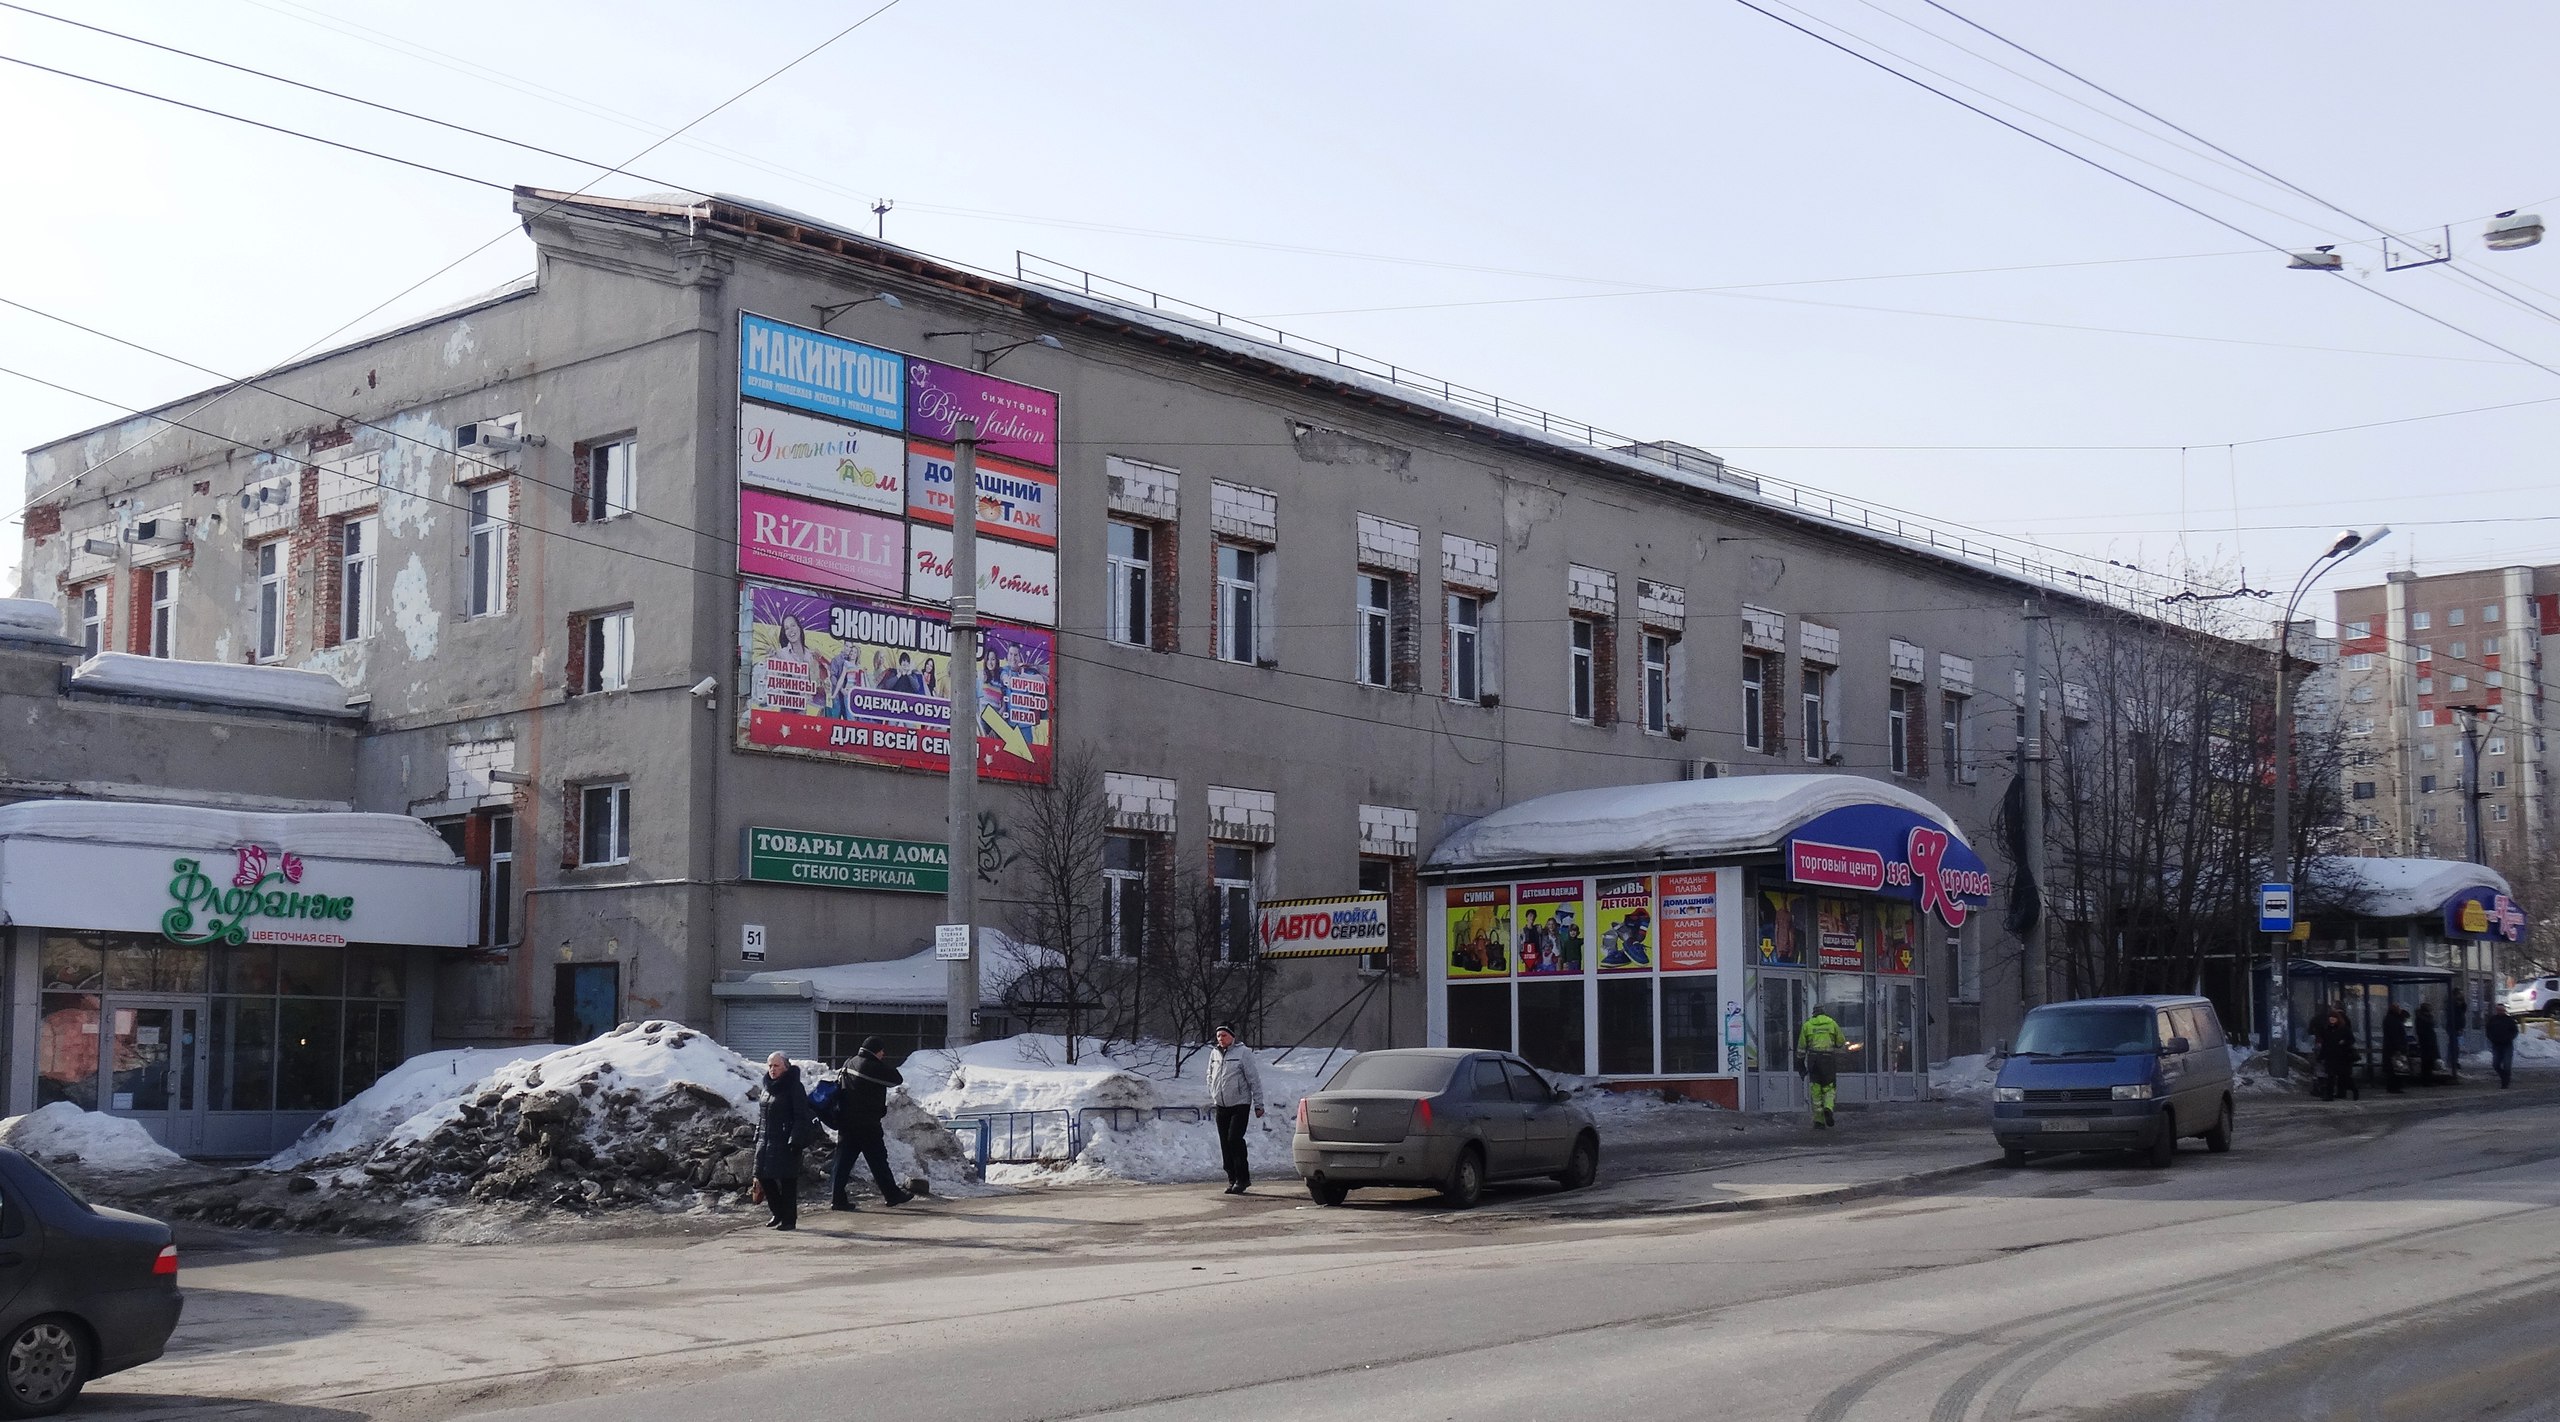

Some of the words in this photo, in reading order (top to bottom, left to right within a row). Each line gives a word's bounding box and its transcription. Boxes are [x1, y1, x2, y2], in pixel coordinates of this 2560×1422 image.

[749, 325, 898, 404] МАКИНТОШ
[981, 391, 1047, 416] бижутерия
[977, 409, 1047, 445] fashion
[748, 426, 859, 462] Уютный
[924, 462, 1041, 503] ДОАШНИЙ
[926, 490, 1041, 528] ТРОТАЖ
[753, 511, 892, 566] RiZELLi
[815, 558, 856, 573] женская
[999, 574, 1049, 596] стиль
[831, 607, 917, 648] ЭКОНОМ
[920, 620, 984, 657] КЛС
[767, 659, 808, 675] ПЛАТЬЯ
[767, 677, 815, 693] ДЖИНСЫ
[1012, 678, 1045, 693] КУРТКИ
[767, 694, 806, 708] ТУНИКИ
[1011, 695, 1047, 709] ПАЛЬТО
[915, 703, 951, 719] ОБУВ
[1011, 710, 1035, 723] МЕХА
[830, 725, 868, 746] ДЛЯ
[873, 731, 918, 751] ВСЕЙ
[757, 833, 844, 857] ТОВАРЫ
[848, 841, 889, 861] ДЛЯ
[893, 846, 948, 865] ДОМА
[792, 863, 849, 880] СТЕКЛО
[852, 869, 916, 885] ЗЕРКАЛА
[1669, 875, 1708, 885] НАРЯДНЫЕ
[1800, 855, 1847, 873] торговый
[1849, 861, 1878, 880] центр
[1887, 860, 1911, 886] на
[1908, 826, 1991, 928] Кирова
[1522, 888, 1550, 899] ДЕТСКАЯ
[1551, 887, 1578, 897] ОДЕЖДА
[1606, 882, 1644, 895] БУВЬ
[1675, 885, 1702, 893] ПЛАТЬЯ
[1464, 891, 1494, 903] СУМКИ
[1601, 897, 1649, 910] ДЕТСКАЯ
[1663, 895, 1714, 908] ДОМАШНИЙ
[1333, 907, 1378, 925] МОЙКА
[1674, 919, 1704, 928] ХАЛАТЫ
[1274, 912, 1331, 941] АВТО
[1331, 922, 1386, 939] СЕРВИС
[1674, 930, 1703, 939] НОЧНЫЕ
[252, 931, 316, 943] ЦВЕТОЧНАЯ
[318, 934, 345, 944] СЕТЬ
[747, 931, 761, 945] 51
[1671, 939, 1707, 948] СОРОЧКИ
[1672, 950, 1707, 959] ПИЖАМЫ
